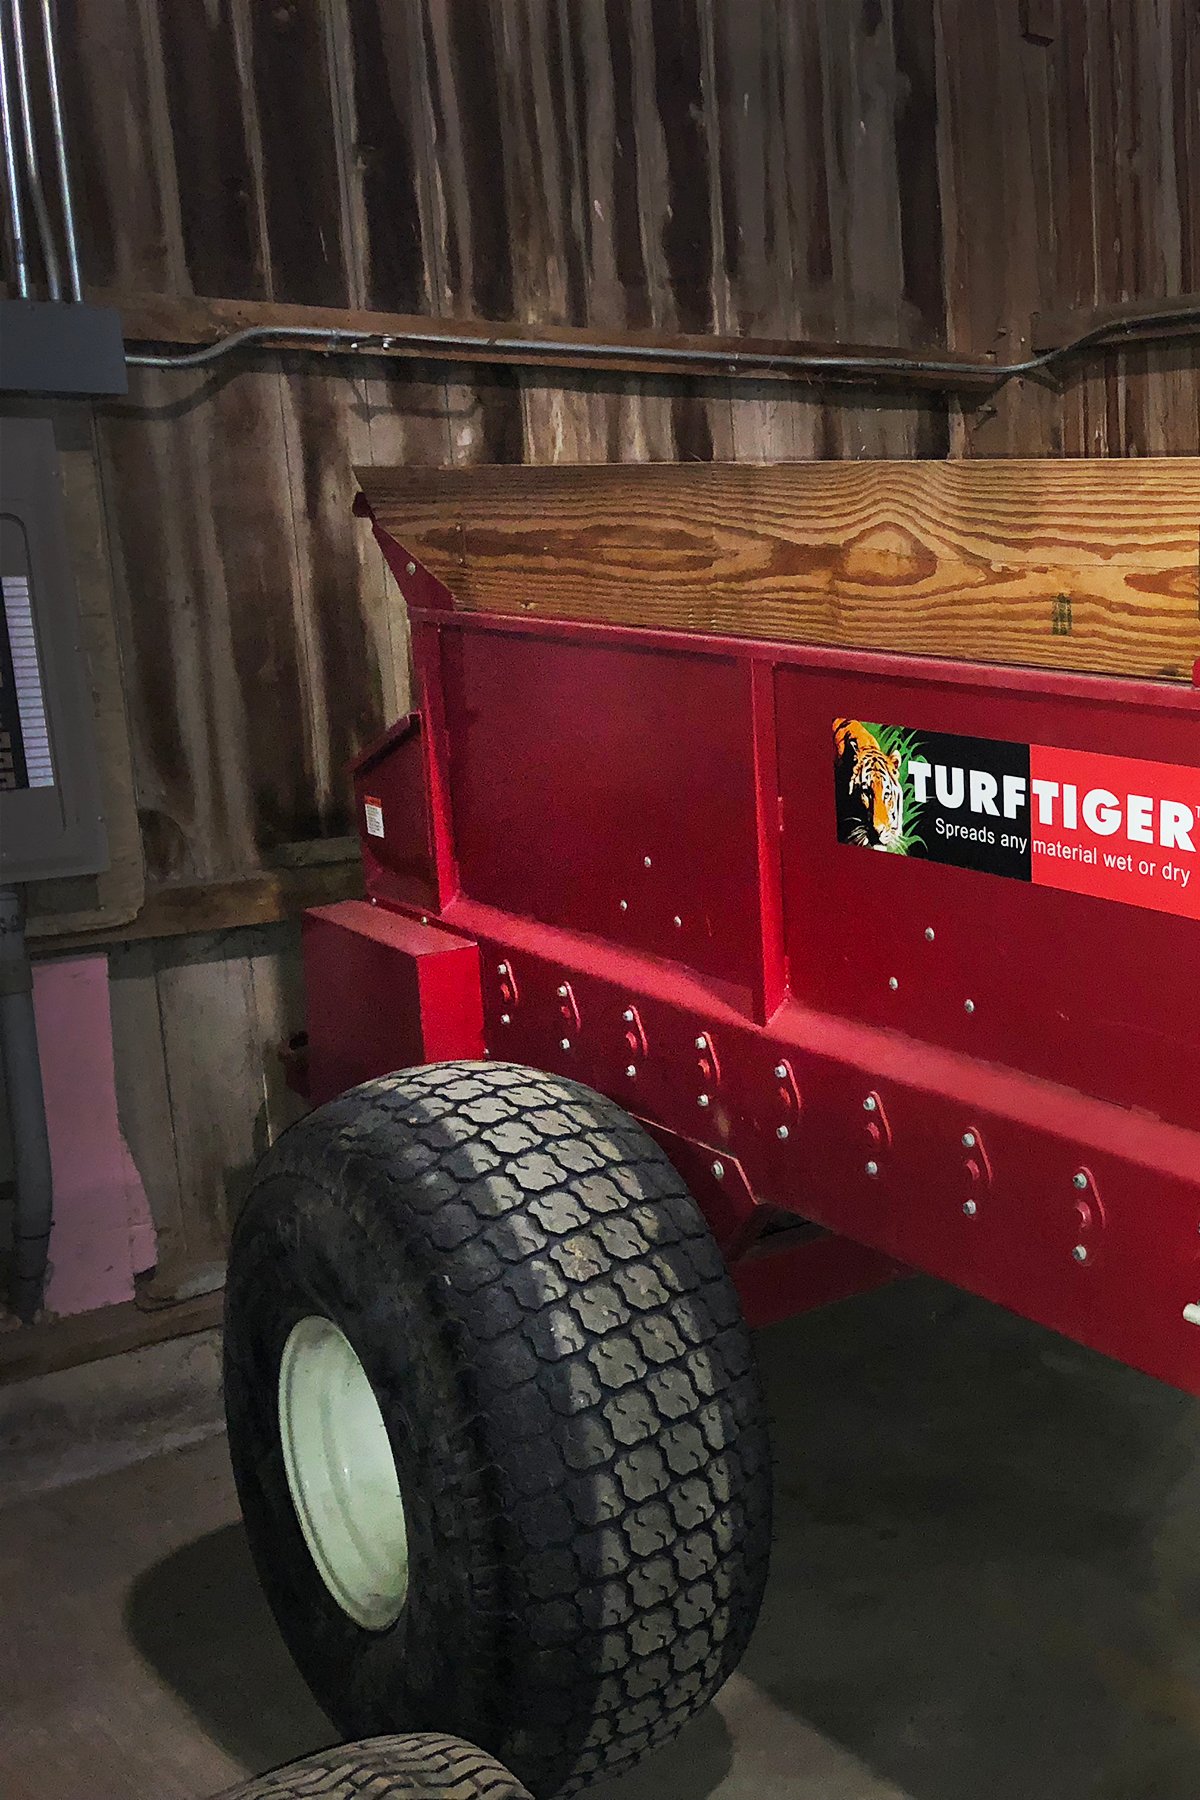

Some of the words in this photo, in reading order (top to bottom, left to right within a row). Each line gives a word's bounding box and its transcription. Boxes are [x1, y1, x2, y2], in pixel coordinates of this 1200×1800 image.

[935, 818, 996, 845] Spreads
[1000, 832, 1028, 855] any
[1032, 837, 1098, 866] material
[1103, 853, 1133, 873] wet
[1138, 859, 1157, 876] or
[1161, 863, 1191, 888] dry
